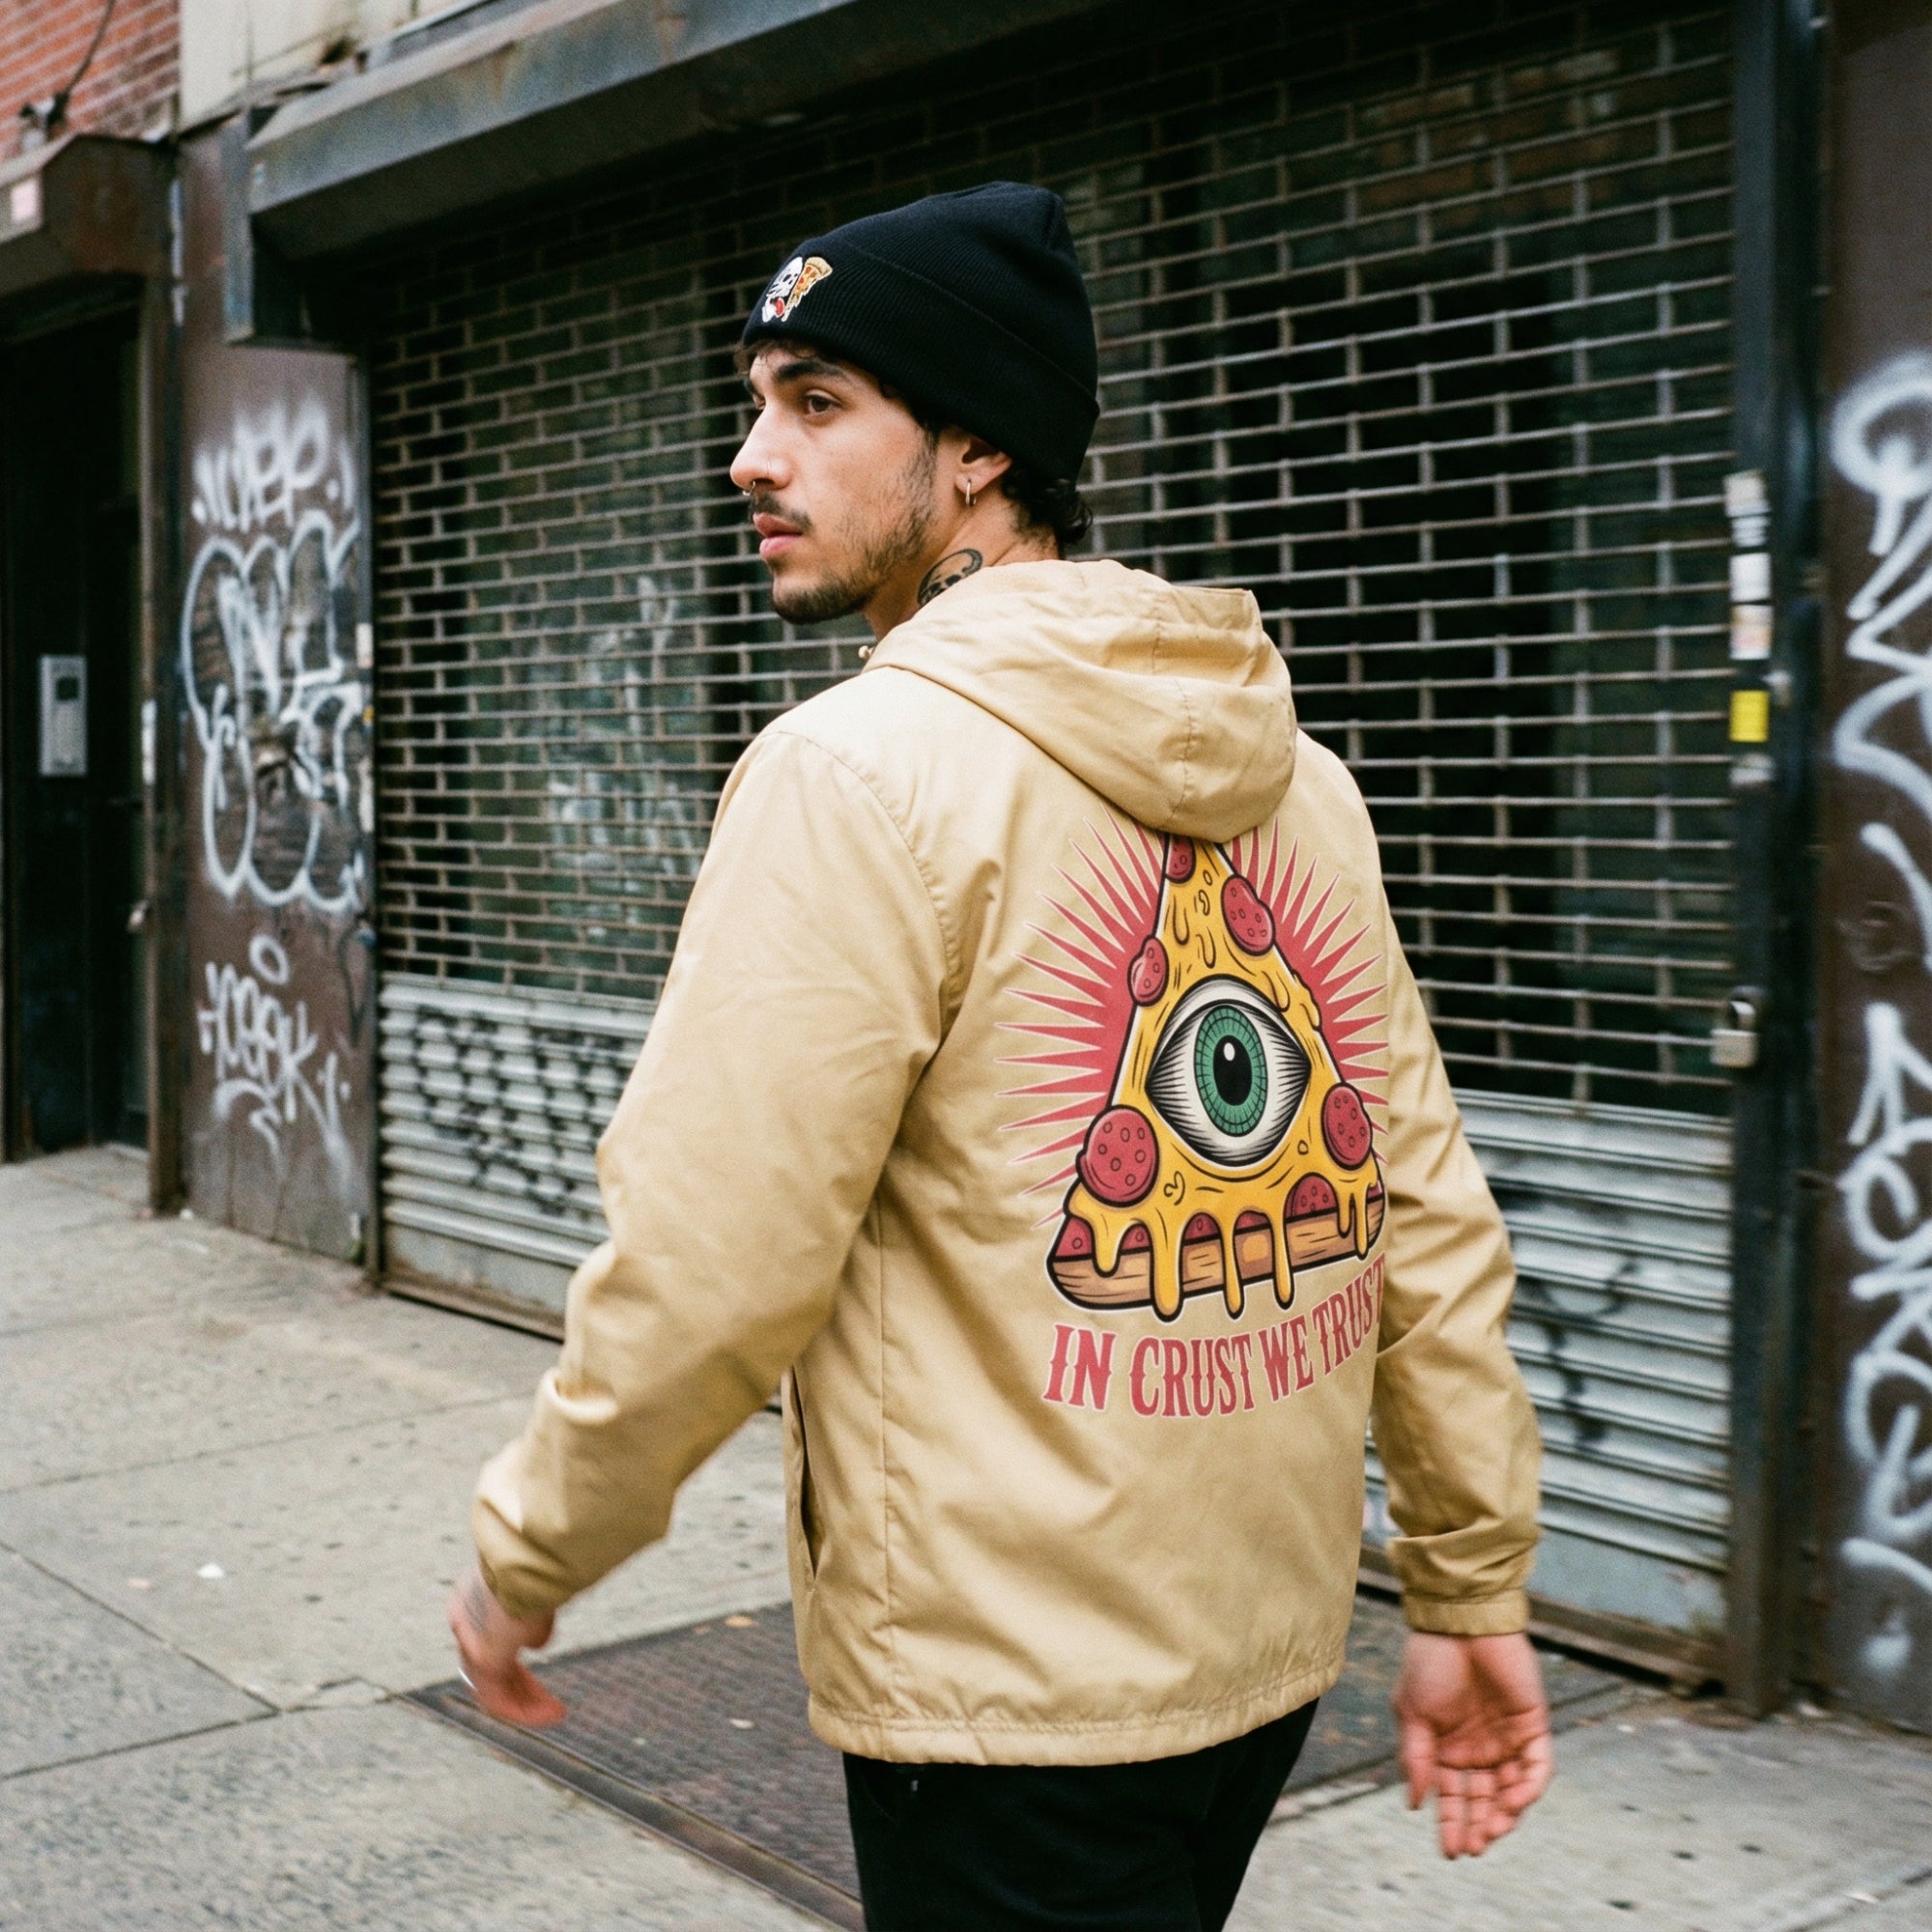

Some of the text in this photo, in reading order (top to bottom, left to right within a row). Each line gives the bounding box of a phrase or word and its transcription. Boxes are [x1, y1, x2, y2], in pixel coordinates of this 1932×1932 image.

[1042, 1252, 1385, 1418] IN CRUST WE TRUST
